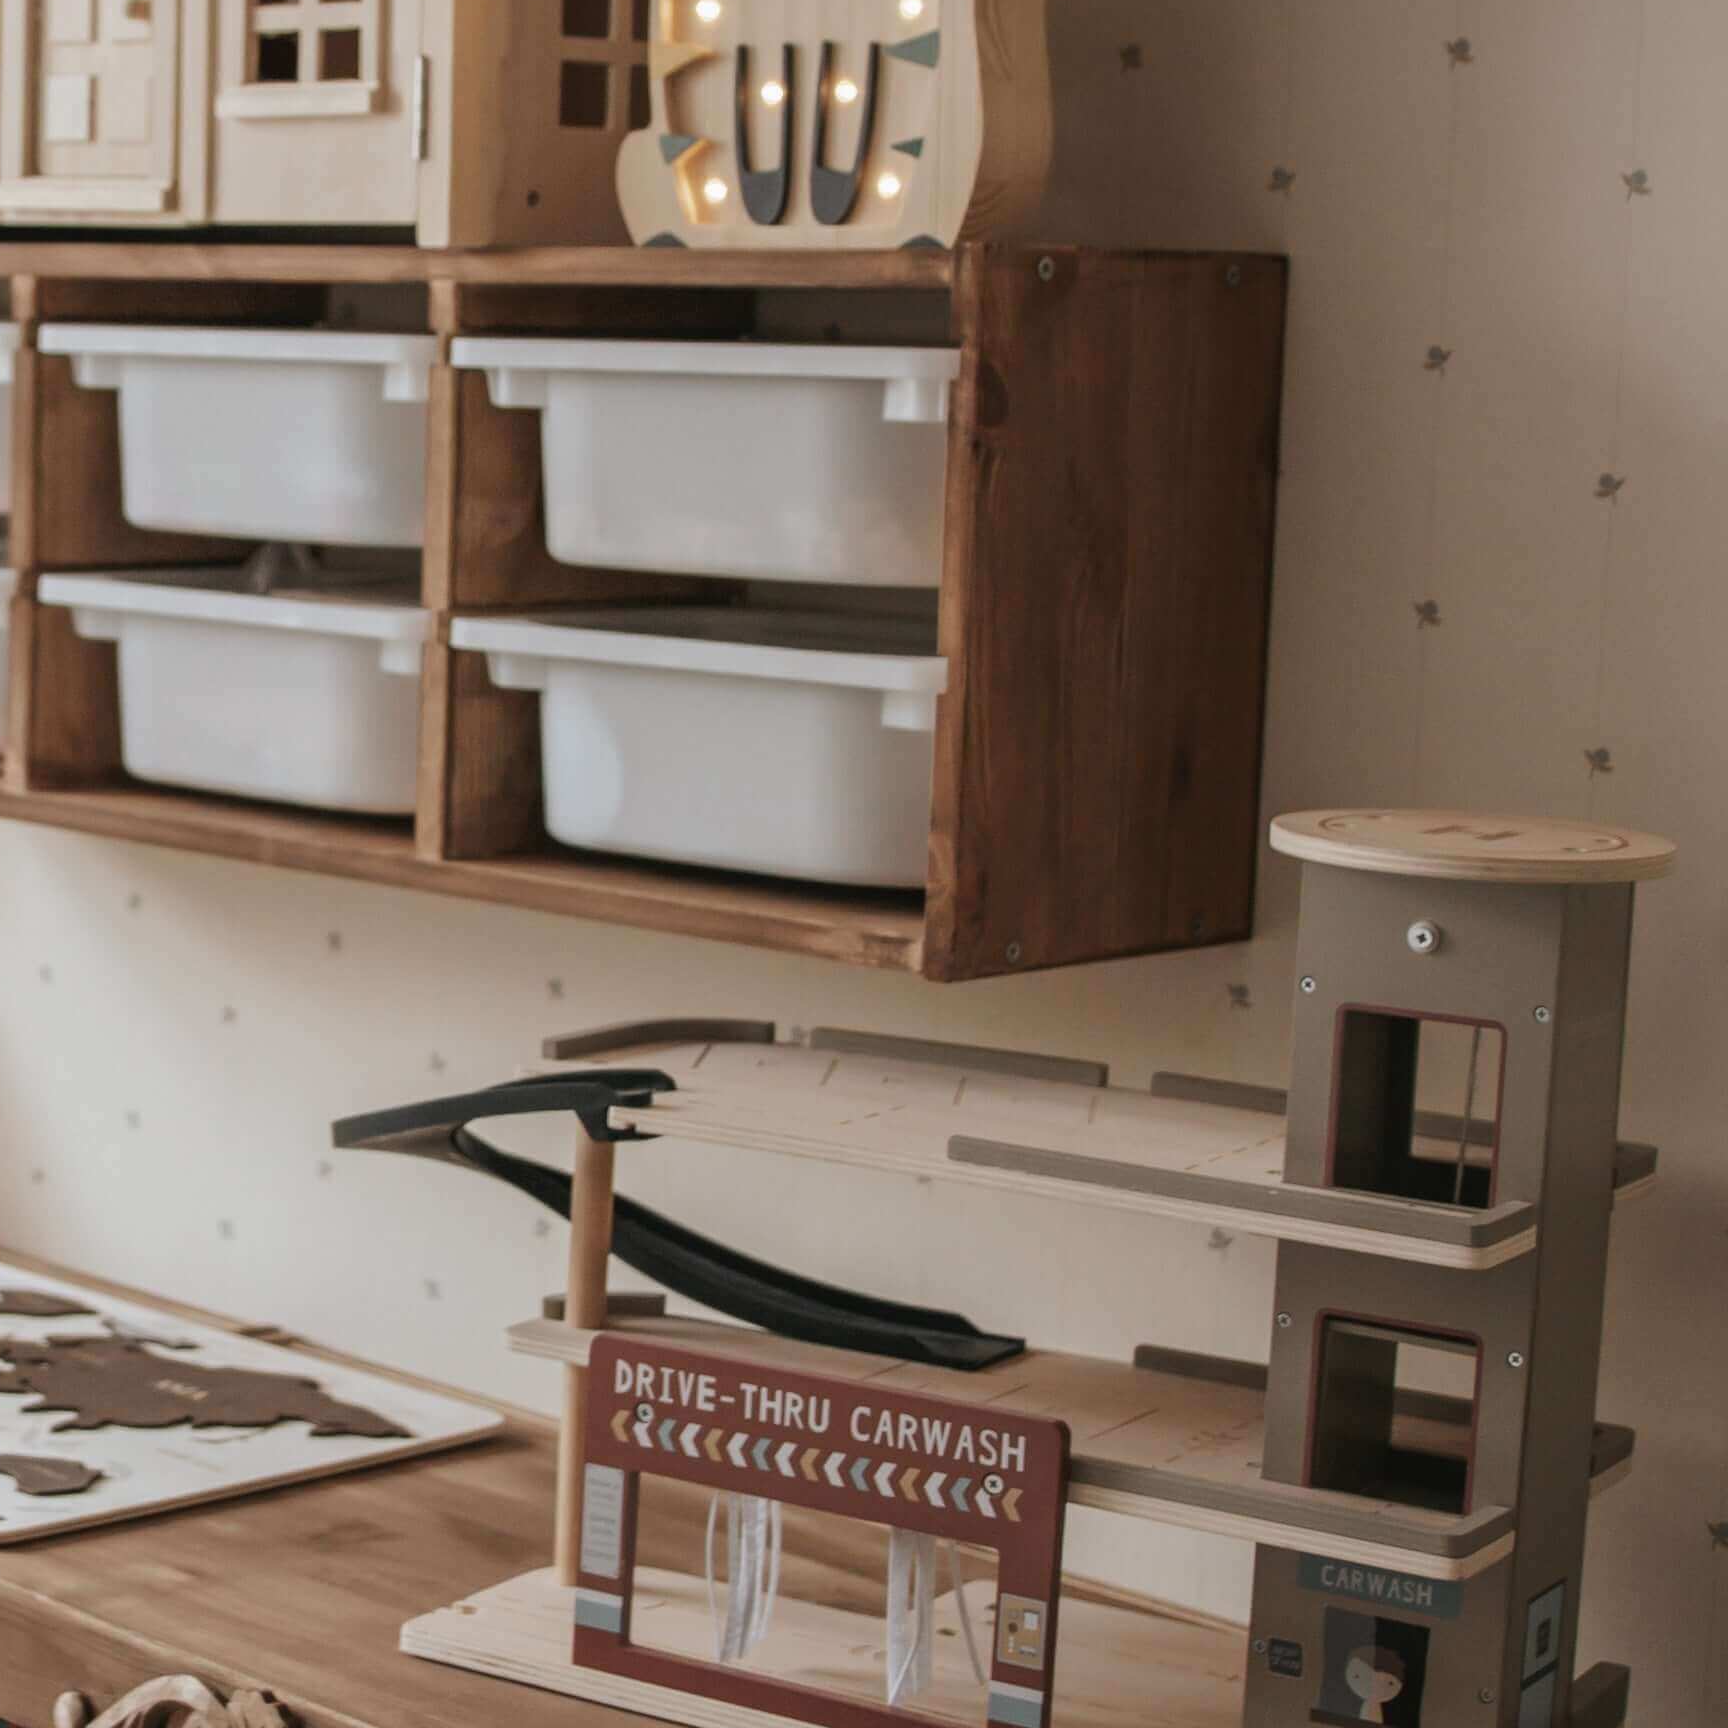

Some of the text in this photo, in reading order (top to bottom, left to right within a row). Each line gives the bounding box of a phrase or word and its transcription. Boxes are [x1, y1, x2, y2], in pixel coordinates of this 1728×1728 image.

[614, 1358, 1026, 1472] DRIVE-THRU CARWASH
[1321, 1566, 1433, 1606] CARWASH
